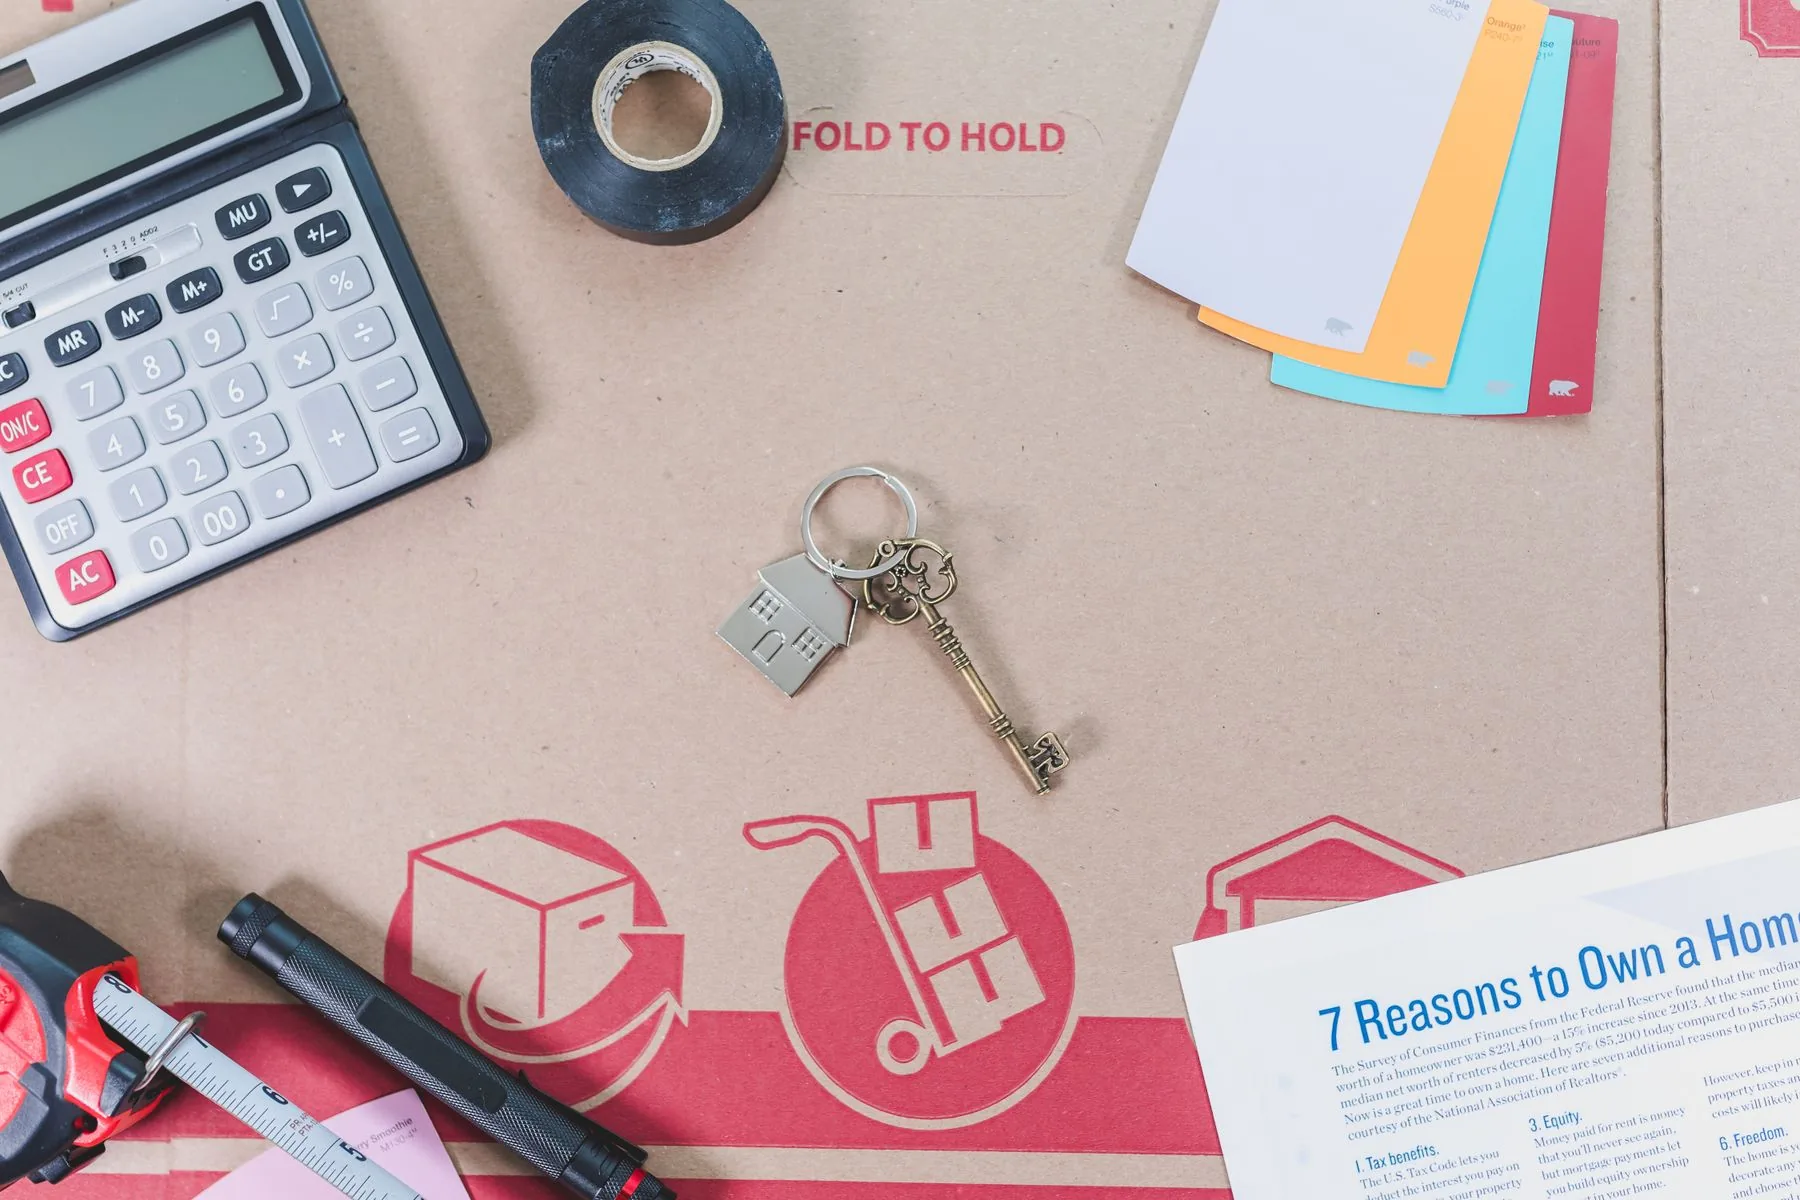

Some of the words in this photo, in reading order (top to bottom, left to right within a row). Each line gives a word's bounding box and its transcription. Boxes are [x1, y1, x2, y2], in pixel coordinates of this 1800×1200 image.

[793, 121, 891, 151] FOLD
[900, 122, 950, 151] TO
[961, 122, 1065, 151] HOLD
[229, 204, 257, 228] MU
[248, 248, 273, 271] GT
[182, 279, 208, 302] M+
[121, 305, 145, 328] M-
[58, 330, 84, 355] MR
[205, 328, 221, 352] 9
[0, 361, 14, 382] C
[144, 356, 161, 380] 8
[80, 380, 96, 407] 7
[227, 379, 245, 403] 6
[0, 411, 39, 442] ON/C
[167, 405, 184, 429] 5
[107, 433, 123, 456] 4
[251, 432, 267, 456] 3
[22, 461, 52, 488] CE
[187, 458, 207, 482] 2
[129, 484, 145, 508] 1
[46, 519, 78, 544] OFF
[204, 506, 237, 534] 00
[150, 536, 168, 560] 0
[69, 563, 99, 592] AC
[103, 975, 132, 994] 8
[1319, 1006, 1341, 1051] 7
[1355, 977, 1522, 1043] Reasons
[1529, 964, 1570, 1002] to
[1578, 944, 1665, 990] Own
[1677, 936, 1700, 968] a
[1705, 912, 1800, 961] Hom
[1331, 1064, 1355, 1076] The
[1357, 1054, 1398, 1071] Survey
[1400, 1049, 1411, 1061] of
[1413, 1036, 1473, 1058] Consumer
[1475, 1024, 1527, 1043] Finances
[1530, 1017, 1557, 1030] from
[1560, 1011, 1578, 1022] the
[1581, 999, 1625, 1018] Federal
[1627, 990, 1674, 1008] Reserve
[1676, 979, 1709, 996] found
[1711, 974, 1735, 988] that
[1737, 969, 1756, 982] the
[1336, 1077, 1371, 1093] worth
[1373, 1073, 1384, 1085] of
[1386, 1073, 1393, 1081] a
[1395, 1055, 1463, 1079] homeowner
[1465, 1050, 1487, 1062] was
[1562, 1025, 1584, 1039] 15%
[1587, 1015, 1636, 1033] increase
[1638, 1007, 1667, 1021] since
[1670, 999, 1702, 1014] 2013.
[1704, 995, 1718, 1007] At
[1719, 989, 1737, 1002] the
[1740, 984, 1770, 997] same
[1773, 979, 1799, 990] time
[1341, 1090, 1383, 1109] median
[1386, 1085, 1404, 1098] net
[1406, 1076, 1441, 1093] worth
[1443, 1072, 1454, 1085] of
[1456, 1065, 1498, 1082] renters
[1500, 1049, 1557, 1071] decreased
[1559, 1045, 1575, 1059] by
[1643, 1022, 1675, 1038] today
[1677, 1006, 1736, 1029] compared
[1738, 1006, 1750, 1018] to
[1752, 994, 1793, 1012] $5,500
[1344, 1111, 1371, 1125] Now
[1373, 1107, 1383, 1118] is
[1385, 1106, 1392, 1115] a
[1393, 1098, 1423, 1116] great
[1425, 1092, 1451, 1106] time
[1453, 1088, 1466, 1100] to
[1468, 1083, 1493, 1096] own
[1495, 1080, 1501, 1089] a
[1503, 1072, 1539, 1087] home.
[1540, 1064, 1569, 1078] Here
[1571, 1060, 1590, 1071] are
[1592, 1053, 1625, 1066] seven
[1627, 1035, 1685, 1059] additional
[1688, 1027, 1732, 1045] reasons
[1734, 1023, 1747, 1034] to
[1749, 1012, 1800, 1032] purchase
[1755, 1060, 1781, 1075] keep
[1782, 1058, 1794, 1069] in
[262, 1085, 289, 1105] 6
[1707, 1084, 1755, 1105] property
[1756, 1079, 1786, 1091] taxes
[1348, 1120, 1398, 1141] courtesy
[1400, 1116, 1411, 1128] of
[1413, 1112, 1432, 1125] the
[1434, 1099, 1484, 1120] National
[1487, 1085, 1553, 1108] Association
[1555, 1080, 1567, 1092] of
[1711, 1106, 1741, 1119] costs
[1741, 1098, 1762, 1112] will
[1762, 1092, 1793, 1107] likely
[370, 1118, 414, 1143] Smoothie
[1528, 1118, 1542, 1132] 3.
[1543, 1111, 1582, 1130] Equity.
[1534, 1134, 1571, 1149] Money
[1573, 1127, 1596, 1142] paid
[1598, 1123, 1613, 1135] for
[1615, 1118, 1637, 1130] rent
[1639, 1114, 1648, 1124] is
[1650, 1107, 1686, 1121] money
[1538, 1152, 1563, 1165] that
[1593, 1138, 1623, 1151] never
[1624, 1135, 1641, 1145] see
[1719, 1136, 1732, 1151] 6.
[1733, 1126, 1788, 1147] Freedom.
[339, 1141, 367, 1162] 5
[1366, 1156, 1387, 1171] Tax
[1388, 1145, 1439, 1166] benefits.
[1541, 1168, 1561, 1180] but
[1562, 1158, 1612, 1176] mortgage
[1614, 1147, 1666, 1166] payments
[1667, 1140, 1682, 1150] let
[1723, 1155, 1745, 1166] The
[1747, 1149, 1778, 1162] home
[1779, 1145, 1789, 1154] is
[1360, 1177, 1382, 1189] The
[1384, 1171, 1406, 1183] U.S.
[1407, 1167, 1428, 1178] Tax
[1429, 1159, 1457, 1173] Code
[1459, 1155, 1479, 1166] lets
[1480, 1151, 1500, 1163] you
[1546, 1186, 1566, 1199] you
[1567, 1176, 1595, 1191] build
[1597, 1170, 1630, 1185] equity
[1632, 1156, 1690, 1176] ownership
[1728, 1166, 1775, 1183] decorate
[1776, 1161, 1796, 1171] any
